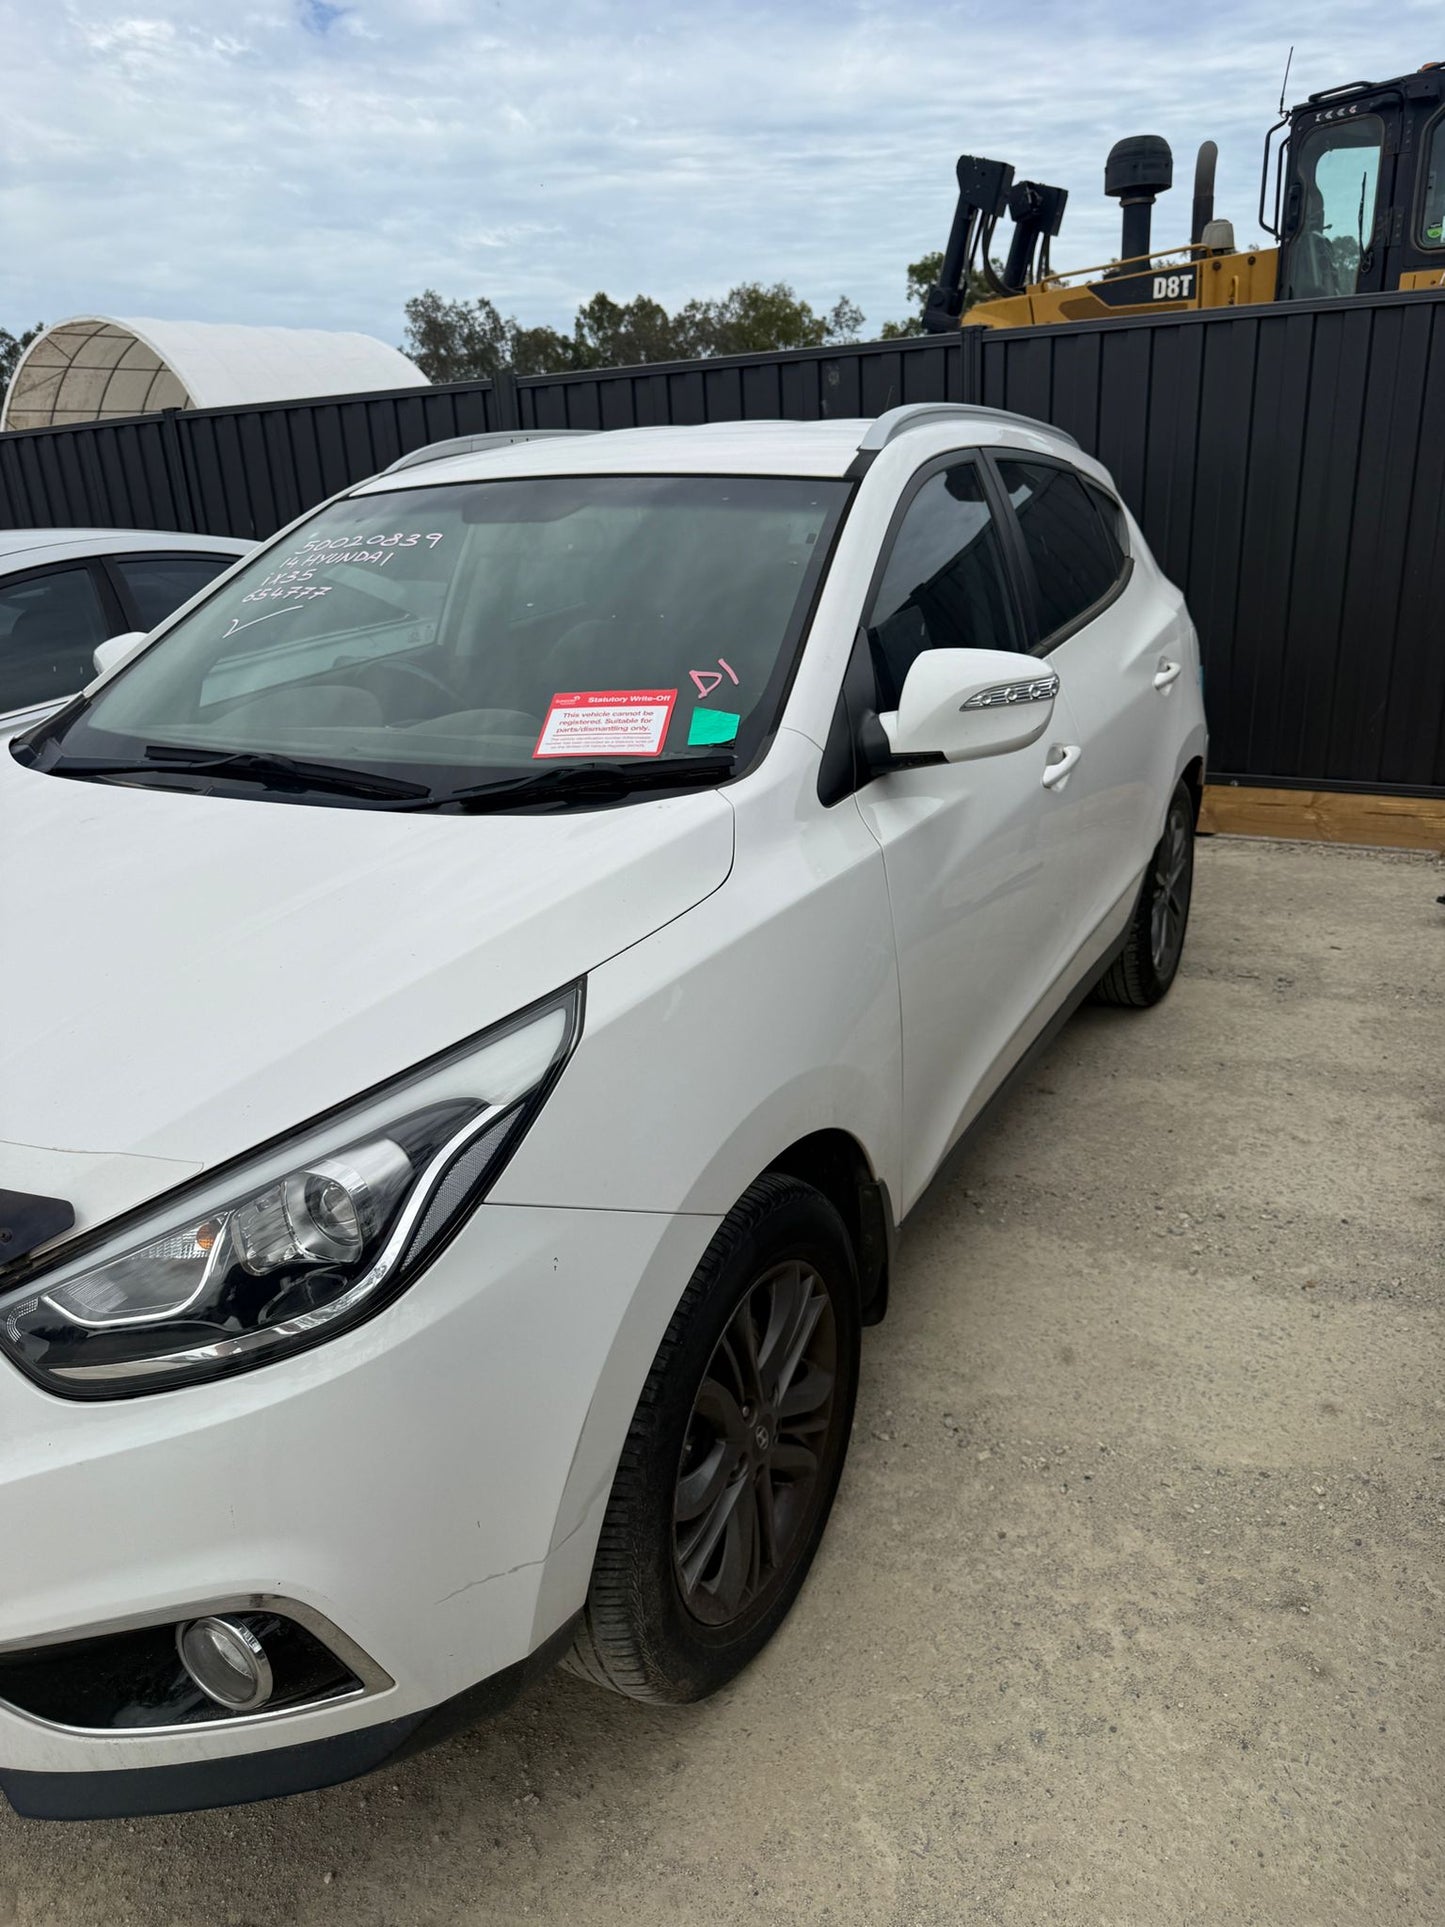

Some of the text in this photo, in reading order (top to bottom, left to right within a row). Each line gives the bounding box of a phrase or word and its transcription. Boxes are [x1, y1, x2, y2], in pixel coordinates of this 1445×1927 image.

[1153, 274, 1193, 299] D8T
[294, 532, 444, 555] 50020839
[301, 551, 394, 567] HYUNDAI
[241, 586, 333, 603] 654777
[587, 695, 672, 704] Statutory Write-Off
[555, 725, 651, 734] parts/dismantling only.
